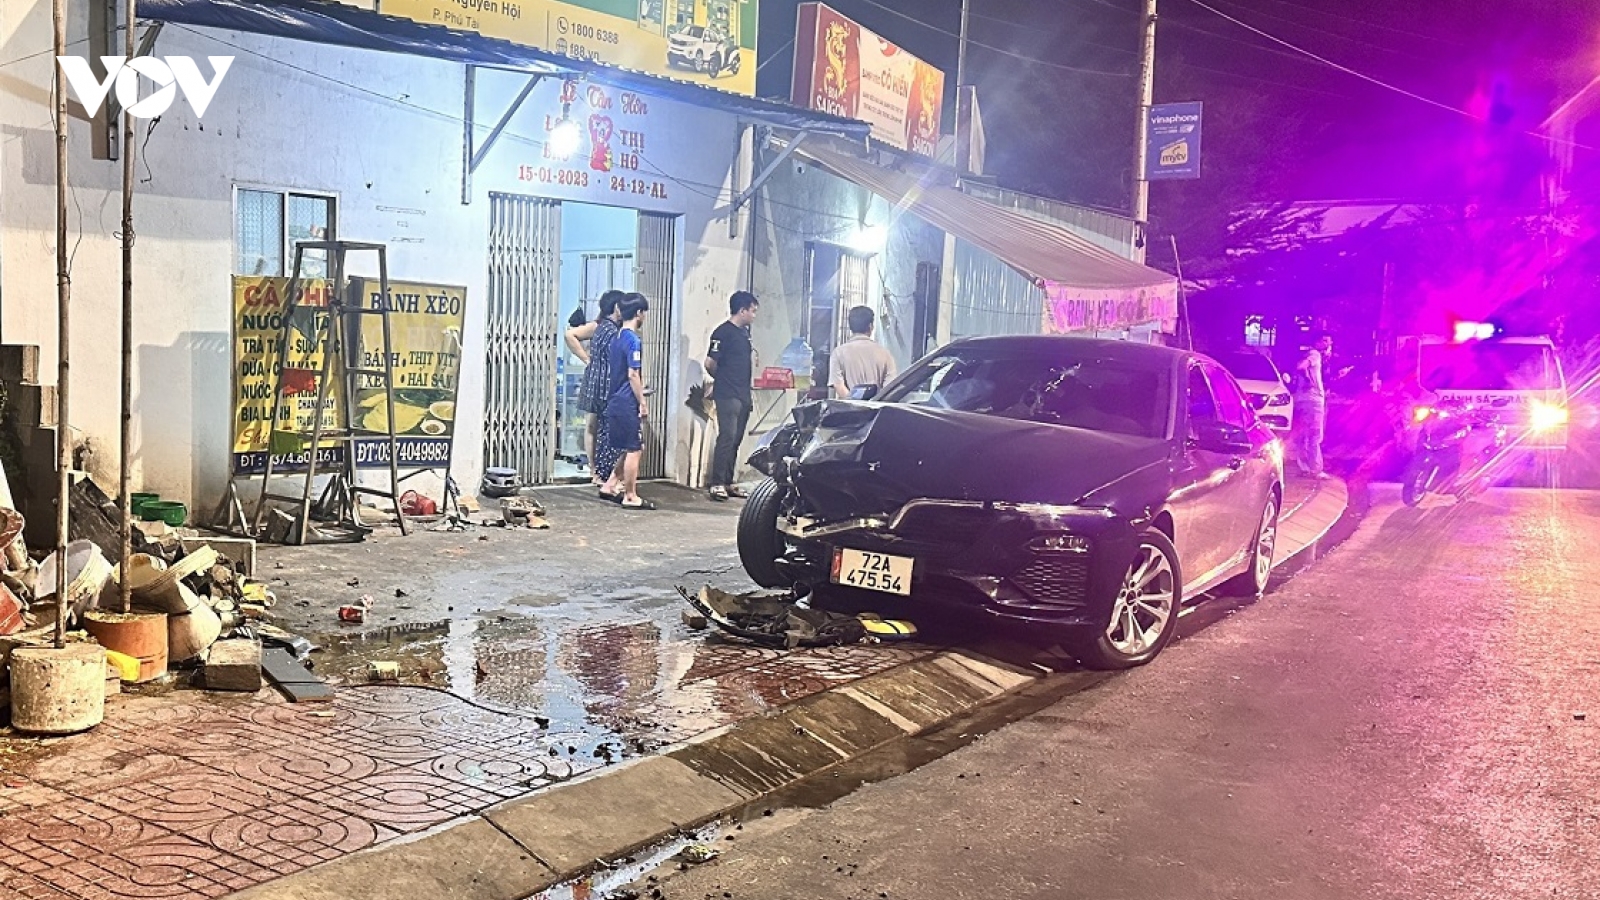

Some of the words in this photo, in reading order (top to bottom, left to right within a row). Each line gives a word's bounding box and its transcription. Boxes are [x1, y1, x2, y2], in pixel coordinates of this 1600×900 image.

[432, 8, 441, 20] P.
[444, 11, 462, 26] Phú
[501, 1, 521, 20] Hội
[571, 22, 594, 39] 1800
[596, 29, 619, 45] 6388
[569, 43, 600, 60] f88.vn
[1151, 114, 1199, 125] vinaphone
[1162, 153, 1187, 163] mytv
[518, 165, 589, 188] 15-01-2023
[610, 176, 668, 199] 24-12-AL
[370, 287, 420, 313] BÁNH
[424, 289, 461, 316] XÈO
[242, 309, 288, 330] NƯỚ
[242, 333, 264, 353] TRÀ
[363, 347, 401, 367] BÁH
[241, 406, 260, 422] BIA
[862, 552, 891, 572] 72A
[846, 569, 902, 592] 475.54
